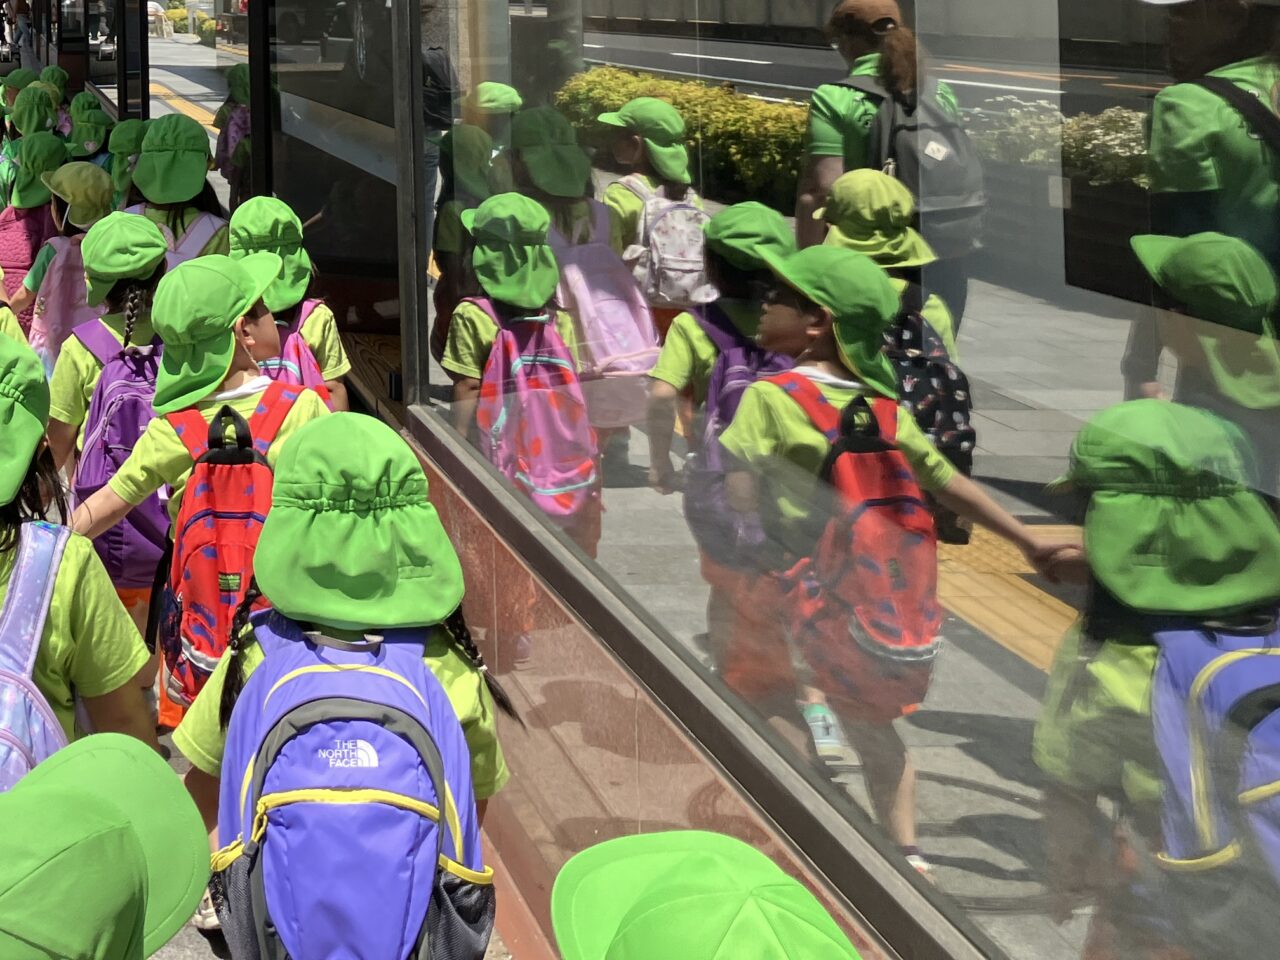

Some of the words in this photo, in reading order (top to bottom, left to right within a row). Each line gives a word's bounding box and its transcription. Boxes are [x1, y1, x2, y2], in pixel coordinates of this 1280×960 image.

[335, 740, 357, 749] THE
[318, 749, 357, 759] NORTH
[329, 759, 357, 768] FACE
